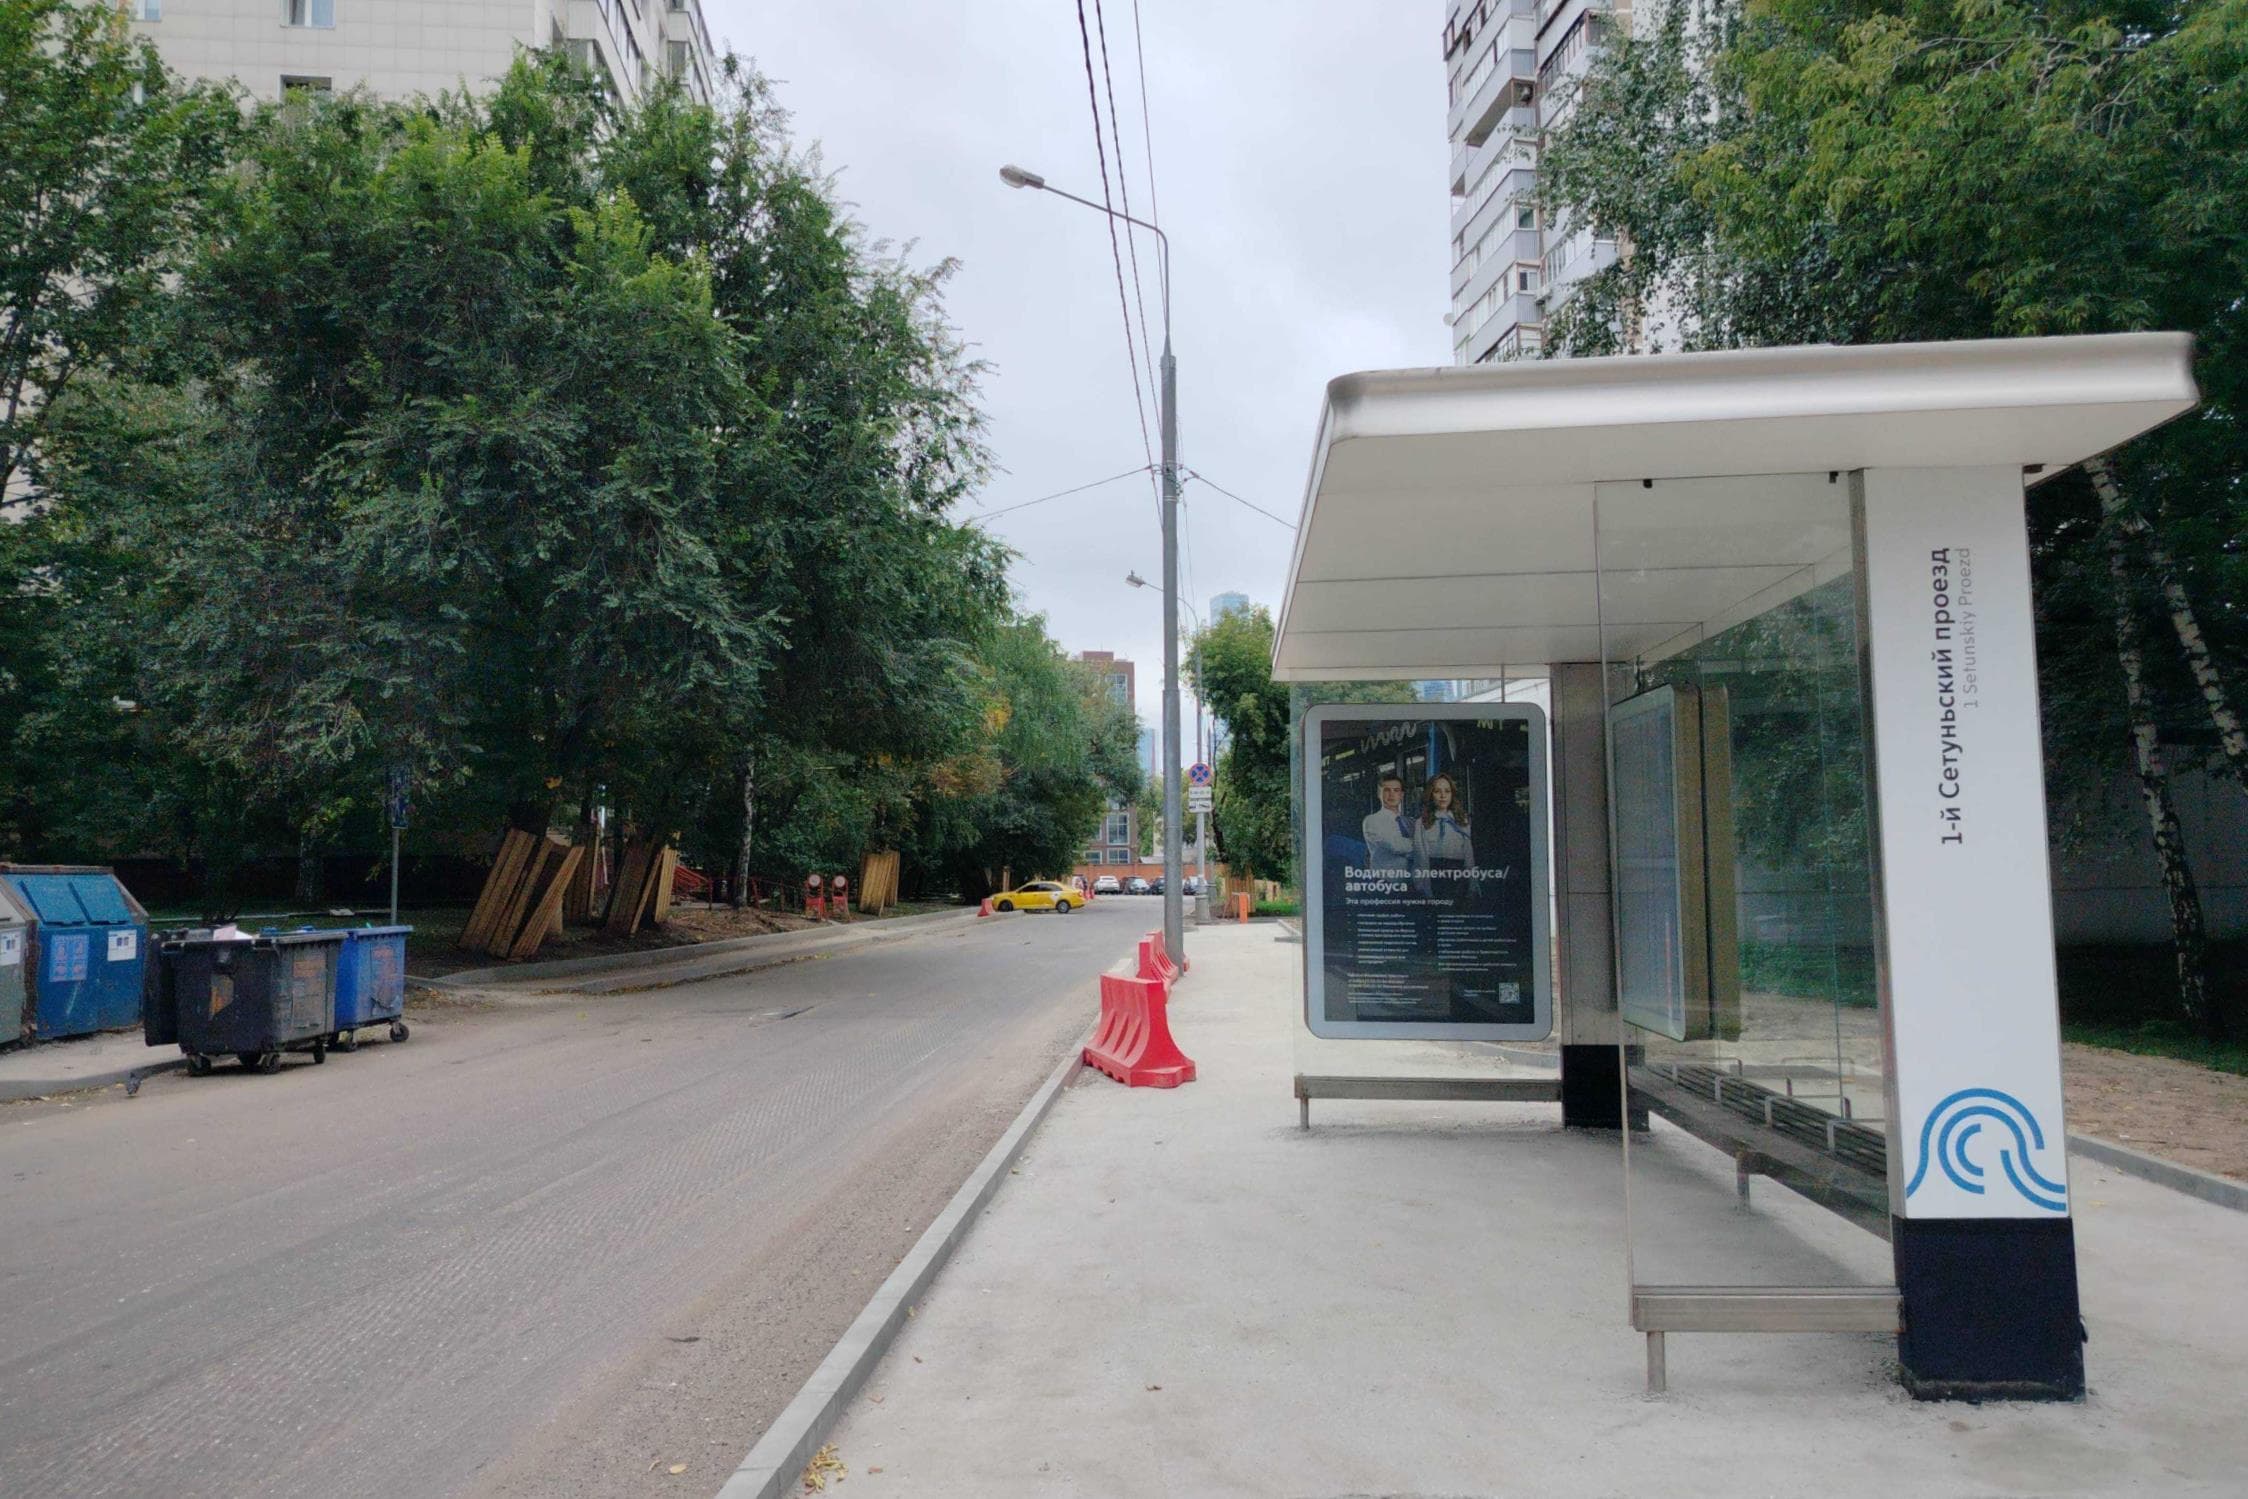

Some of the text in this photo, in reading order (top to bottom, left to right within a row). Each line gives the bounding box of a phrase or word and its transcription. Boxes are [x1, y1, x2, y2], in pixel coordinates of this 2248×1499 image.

[1955, 548, 1978, 708] 1 Setunskiy Proezd
[1931, 548, 1963, 844] 1-й Сетуньский проезд
[1344, 865, 1510, 881] Водитель электробуса/
[1344, 880, 1408, 895] автобуса
[1360, 898, 1401, 906] профессия
[1402, 898, 1426, 906] нужна
[1427, 899, 1454, 907] городу
